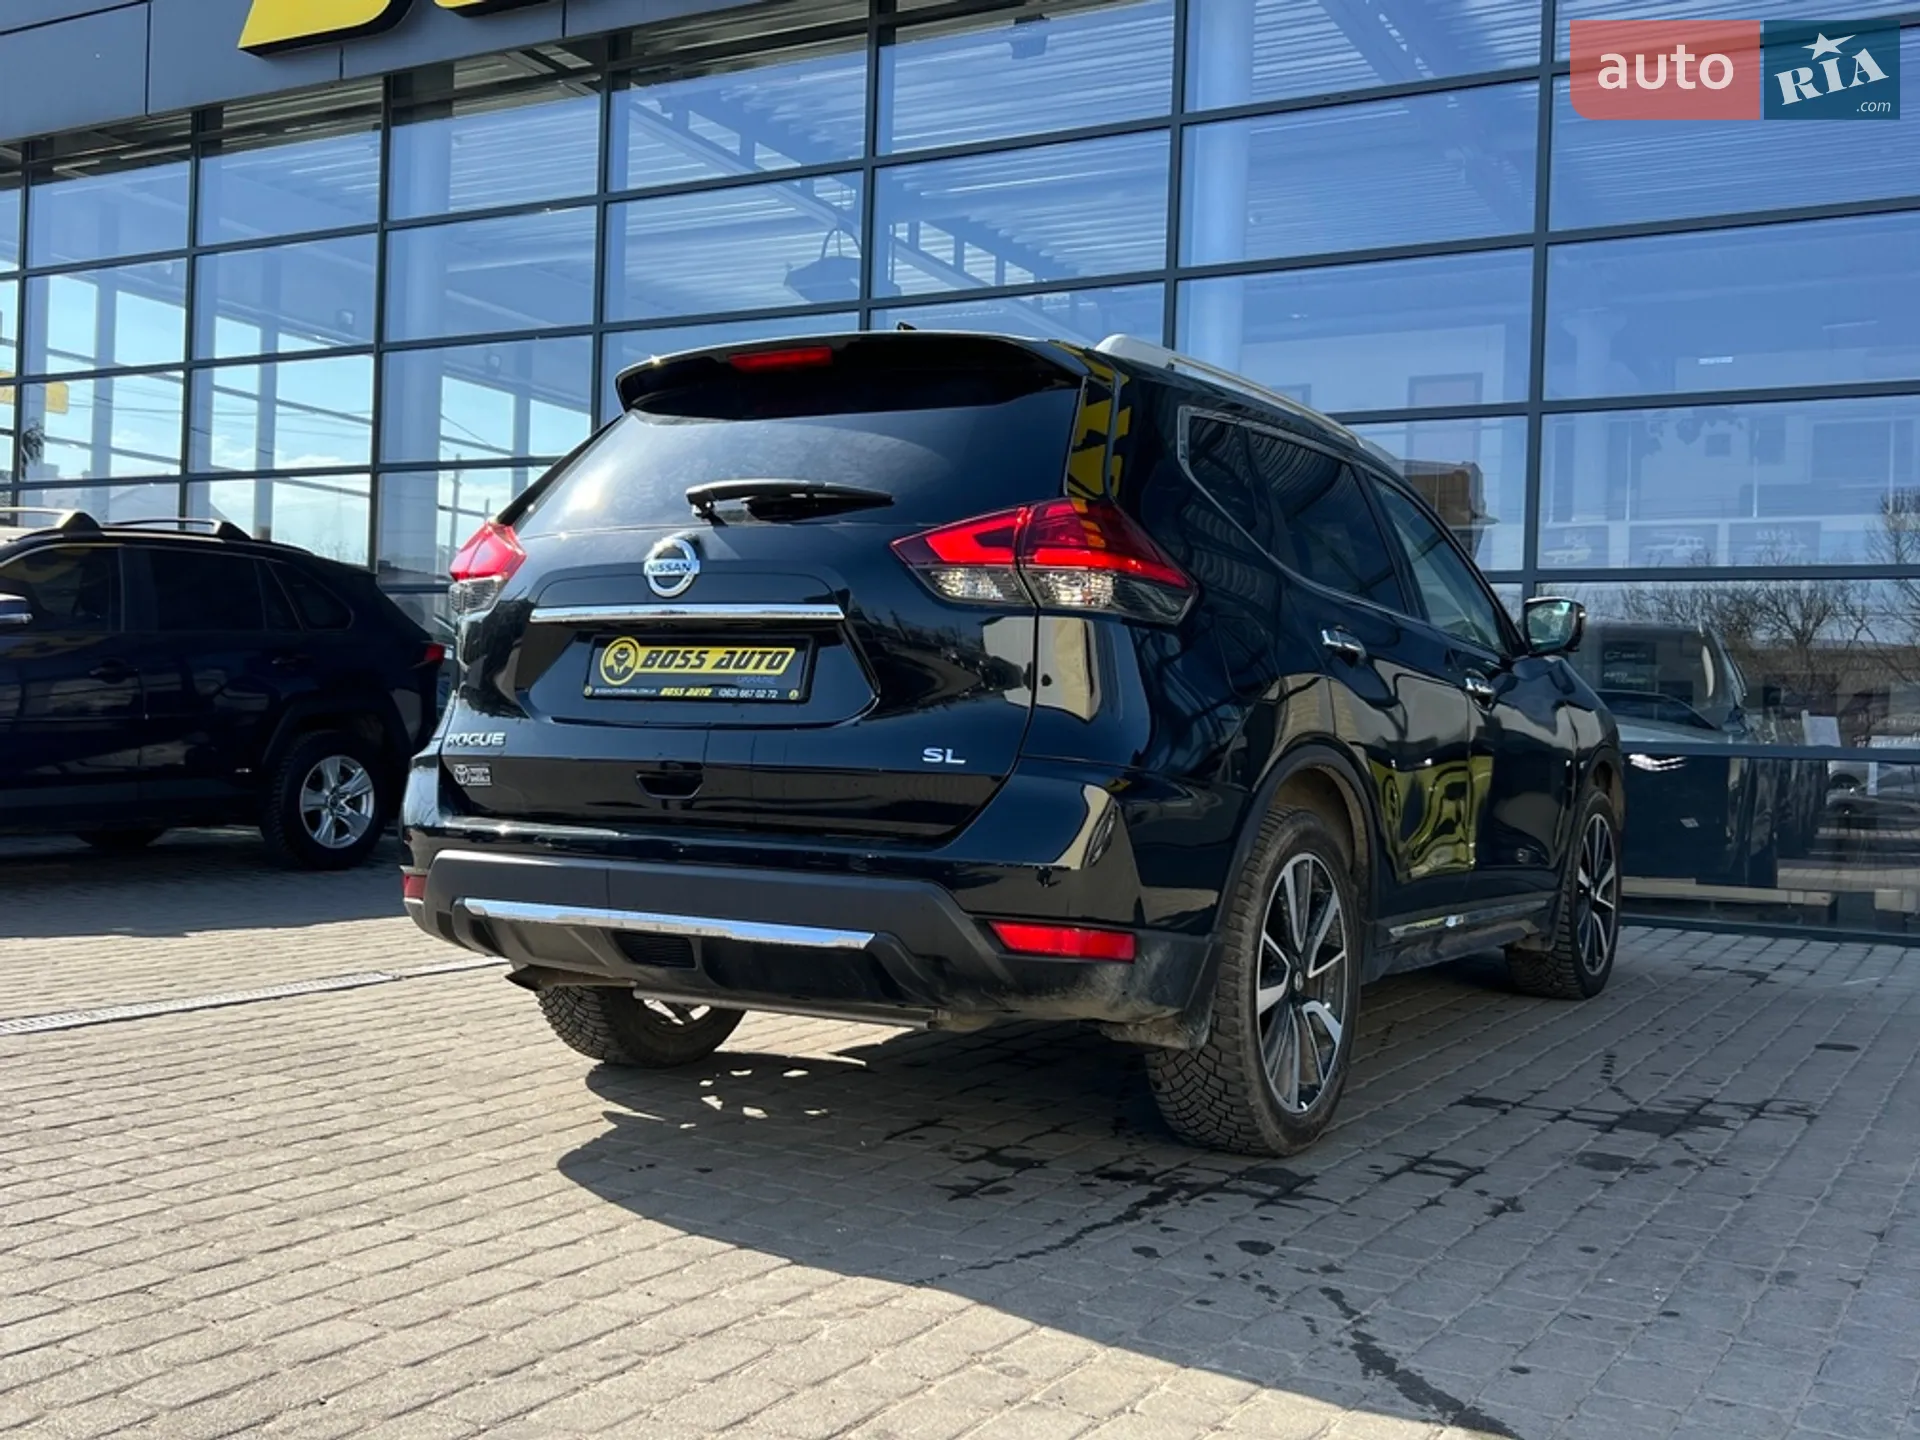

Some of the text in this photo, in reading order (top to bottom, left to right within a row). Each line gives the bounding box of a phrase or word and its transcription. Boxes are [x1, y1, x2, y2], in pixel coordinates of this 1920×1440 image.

[648, 562, 692, 573] NISSAN
[639, 649, 791, 671] BOSS AUTO
[445, 732, 506, 747] ROGUE
[922, 747, 967, 765] SL
